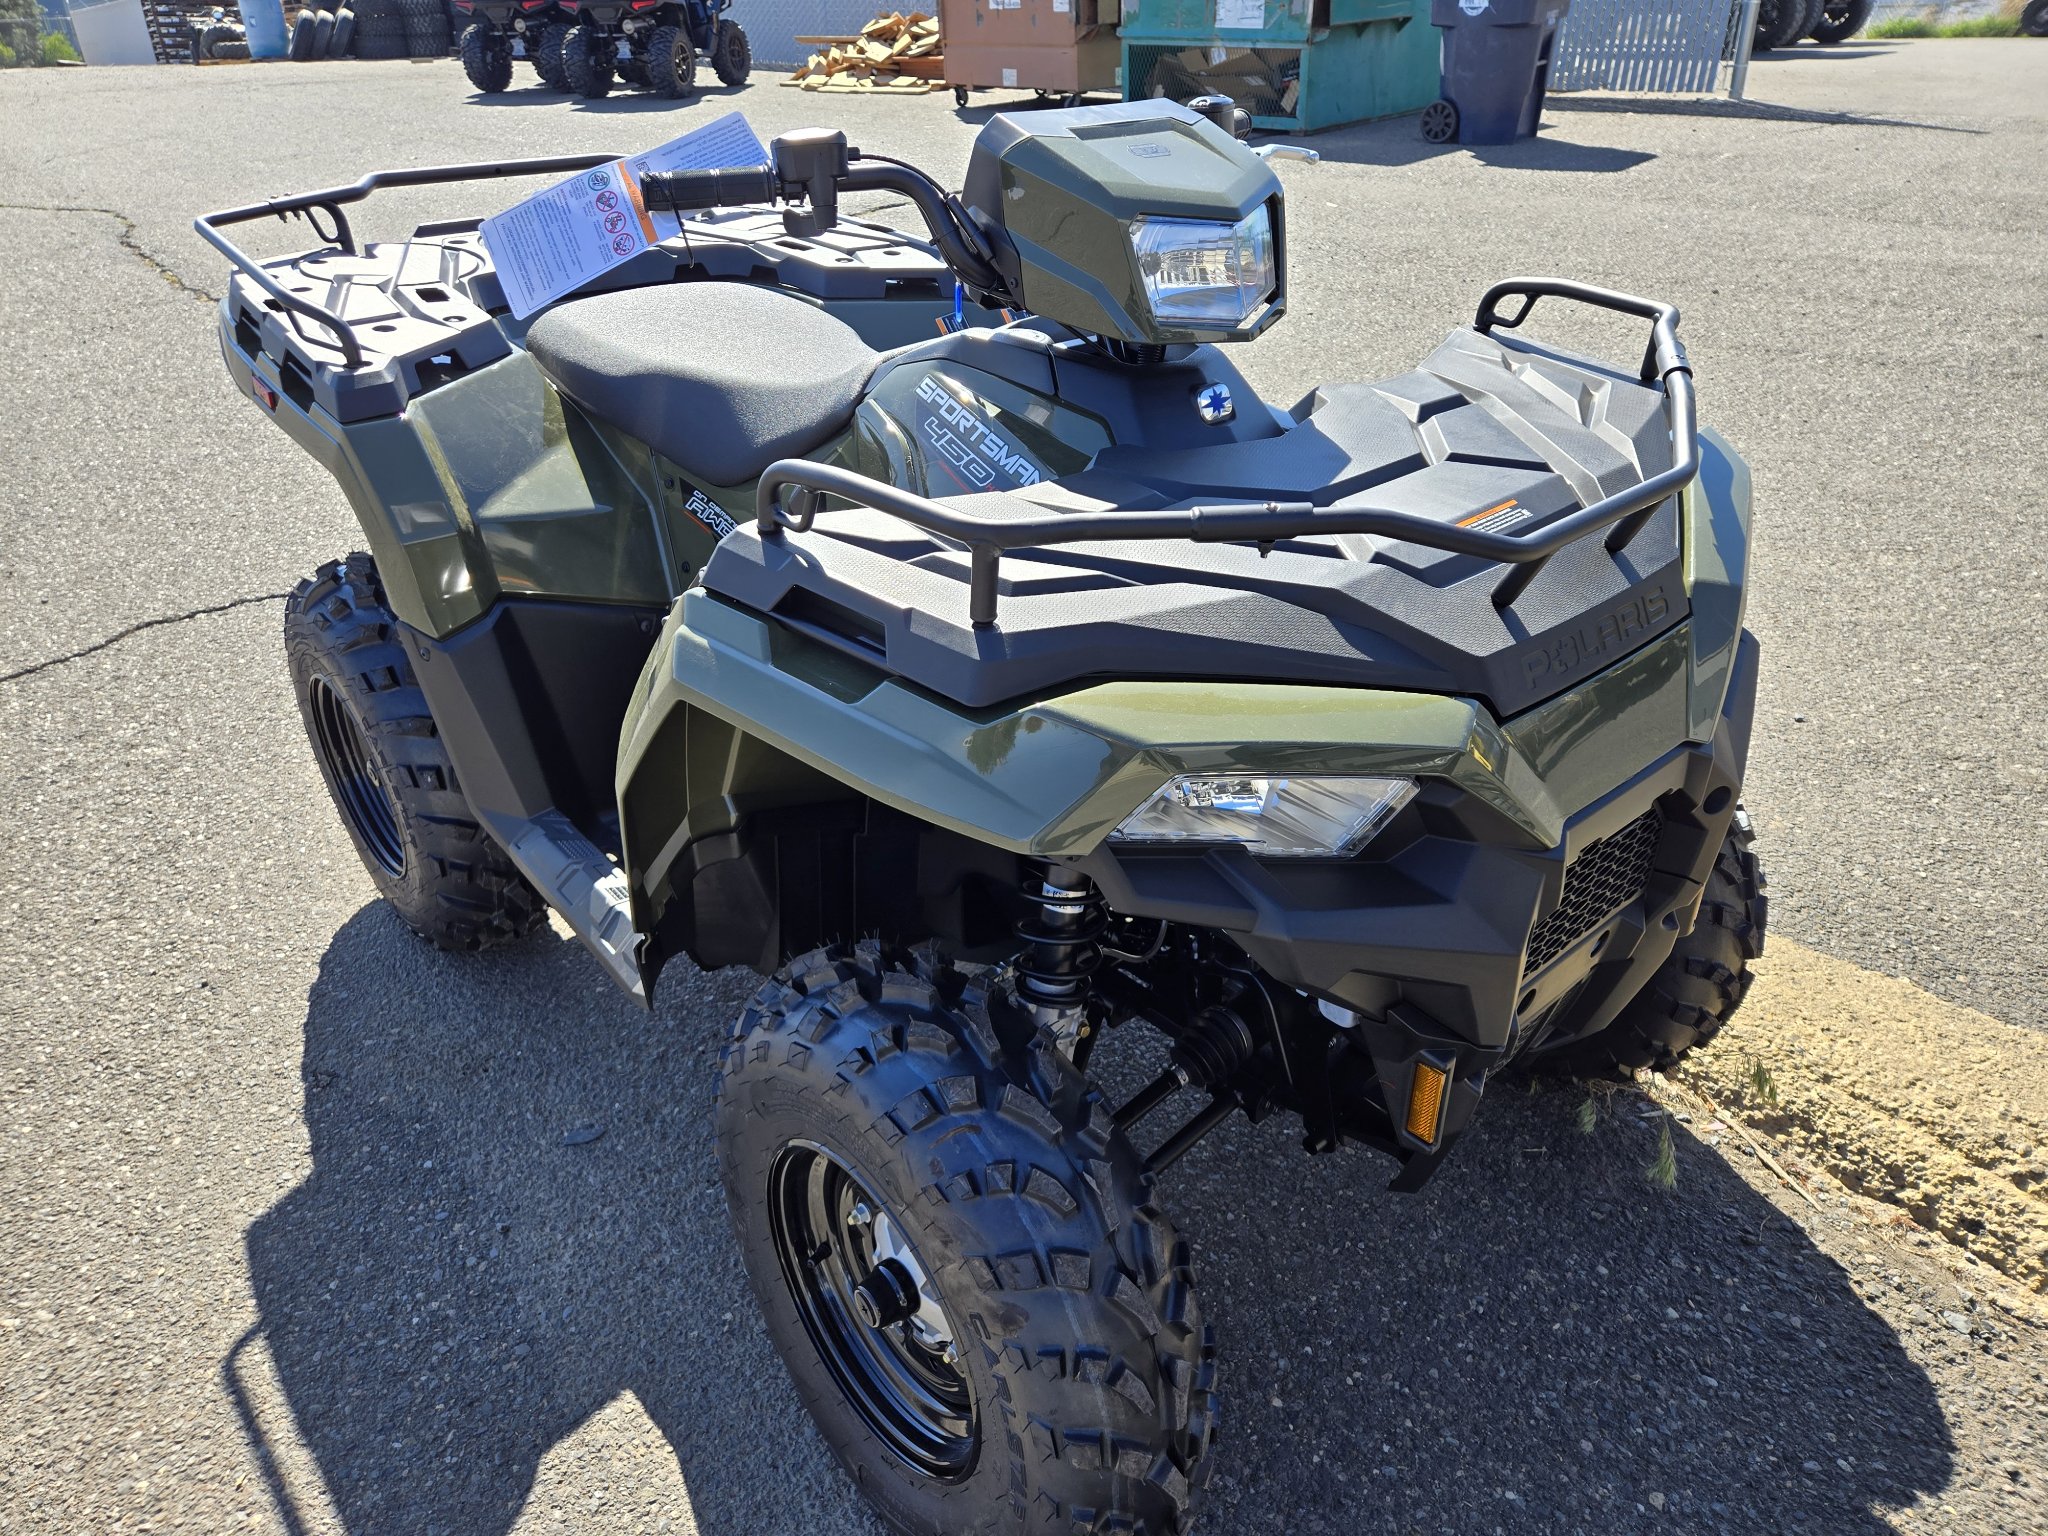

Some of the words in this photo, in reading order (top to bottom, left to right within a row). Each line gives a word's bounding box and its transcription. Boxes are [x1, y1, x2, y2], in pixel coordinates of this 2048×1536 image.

[915, 377, 1041, 487] SPORTSMAN
[924, 416, 996, 487] 450
[708, 501, 738, 529] DEMAN
[1520, 586, 1670, 690] POLARIS
